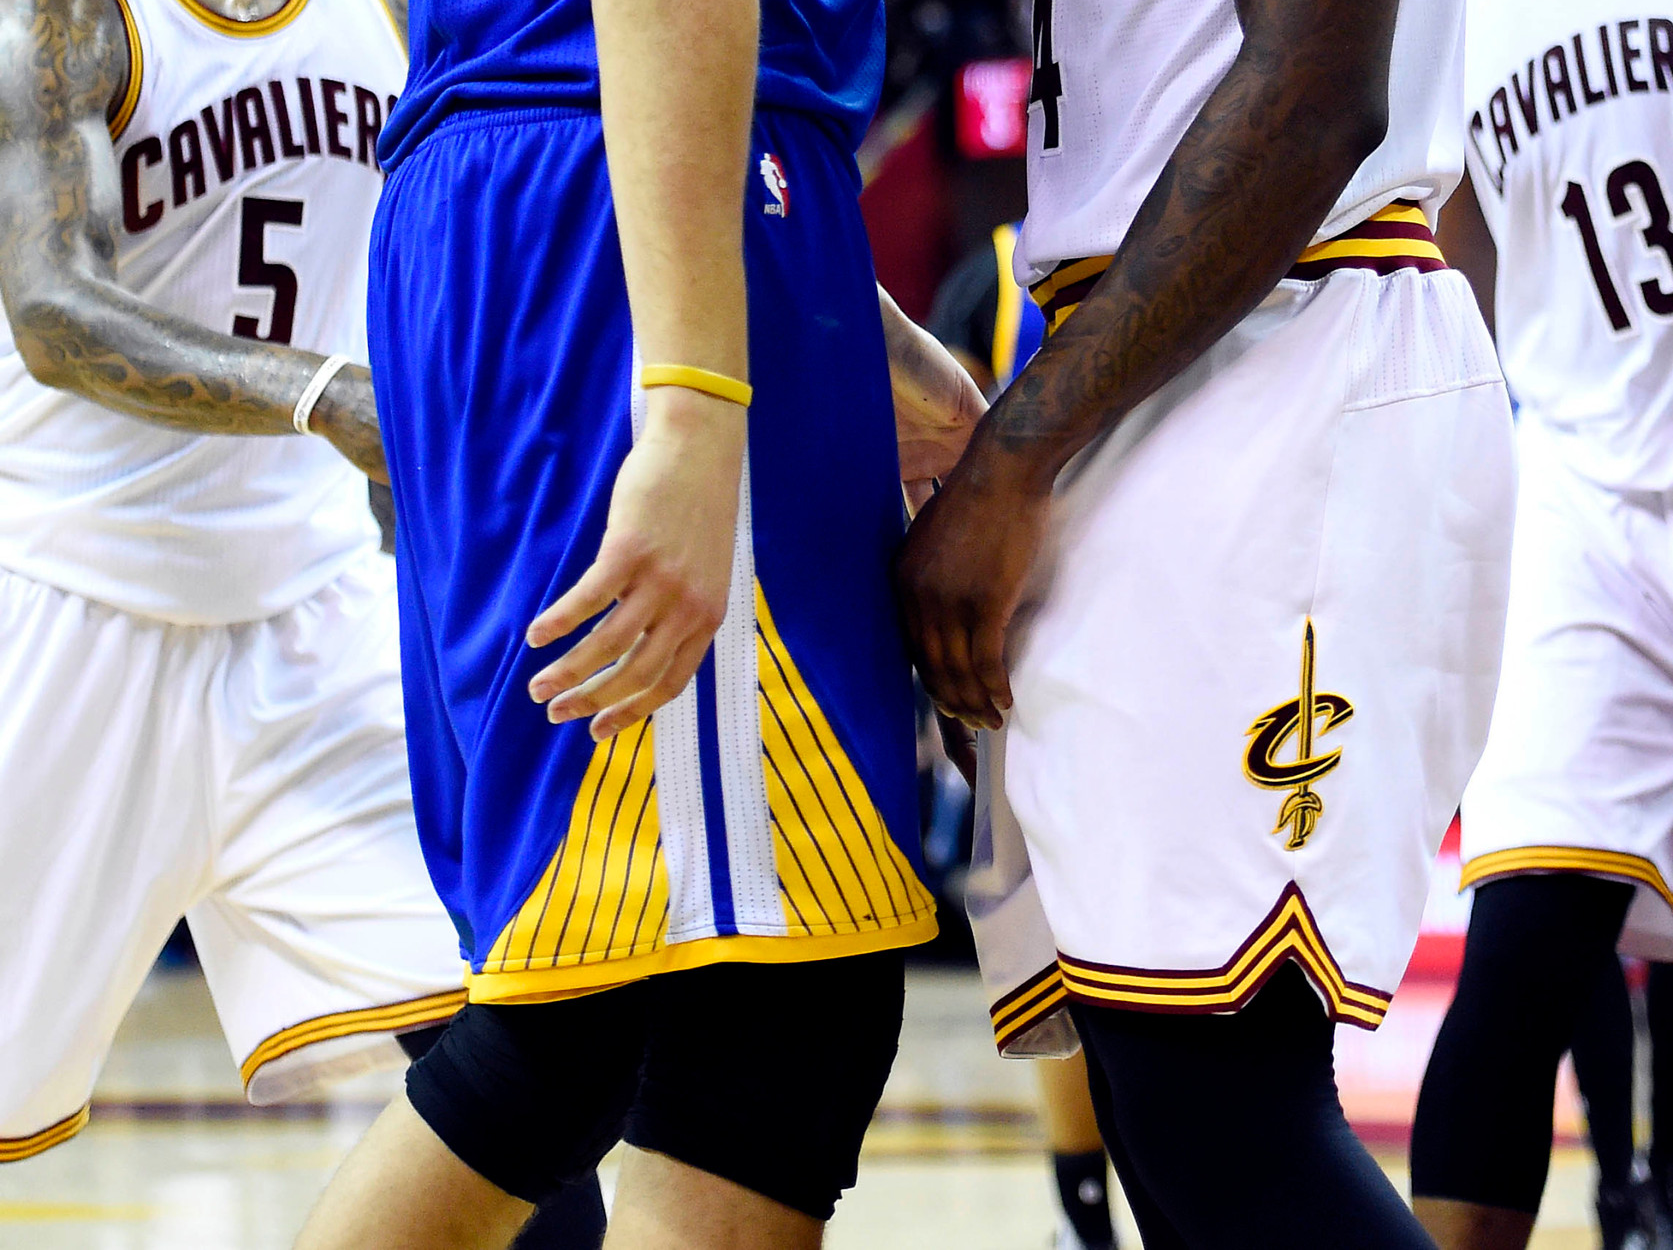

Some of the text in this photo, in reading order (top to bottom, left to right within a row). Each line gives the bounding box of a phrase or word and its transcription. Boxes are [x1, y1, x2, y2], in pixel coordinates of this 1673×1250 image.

[121, 77, 399, 234] CAVALIER
[232, 196, 304, 346] 5
[1561, 161, 1673, 332] 13
